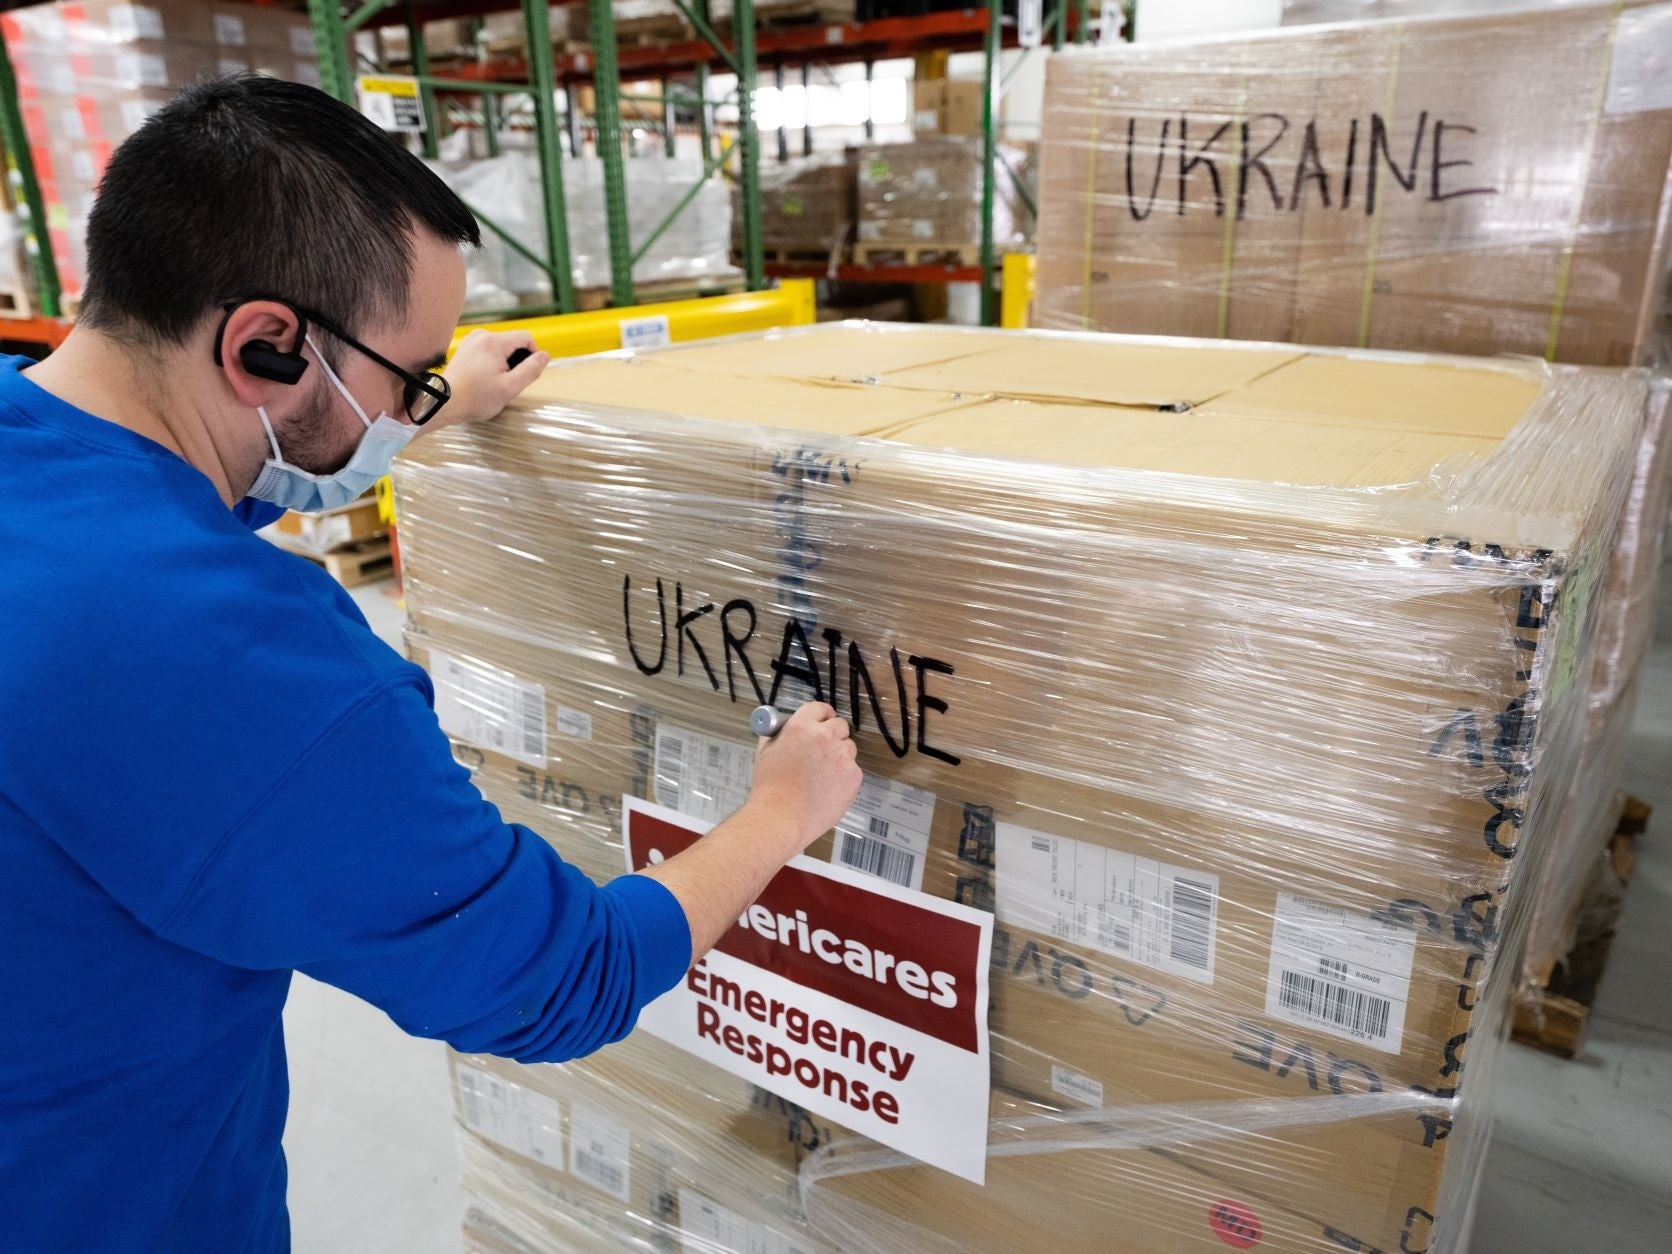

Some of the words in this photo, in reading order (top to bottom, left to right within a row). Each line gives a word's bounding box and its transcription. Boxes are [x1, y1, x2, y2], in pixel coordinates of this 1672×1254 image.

[1124, 110, 1497, 221] UKRAINE
[623, 574, 961, 767] UKRAINE
[688, 960, 915, 1081] Emergency
[696, 1001, 900, 1125] Response
